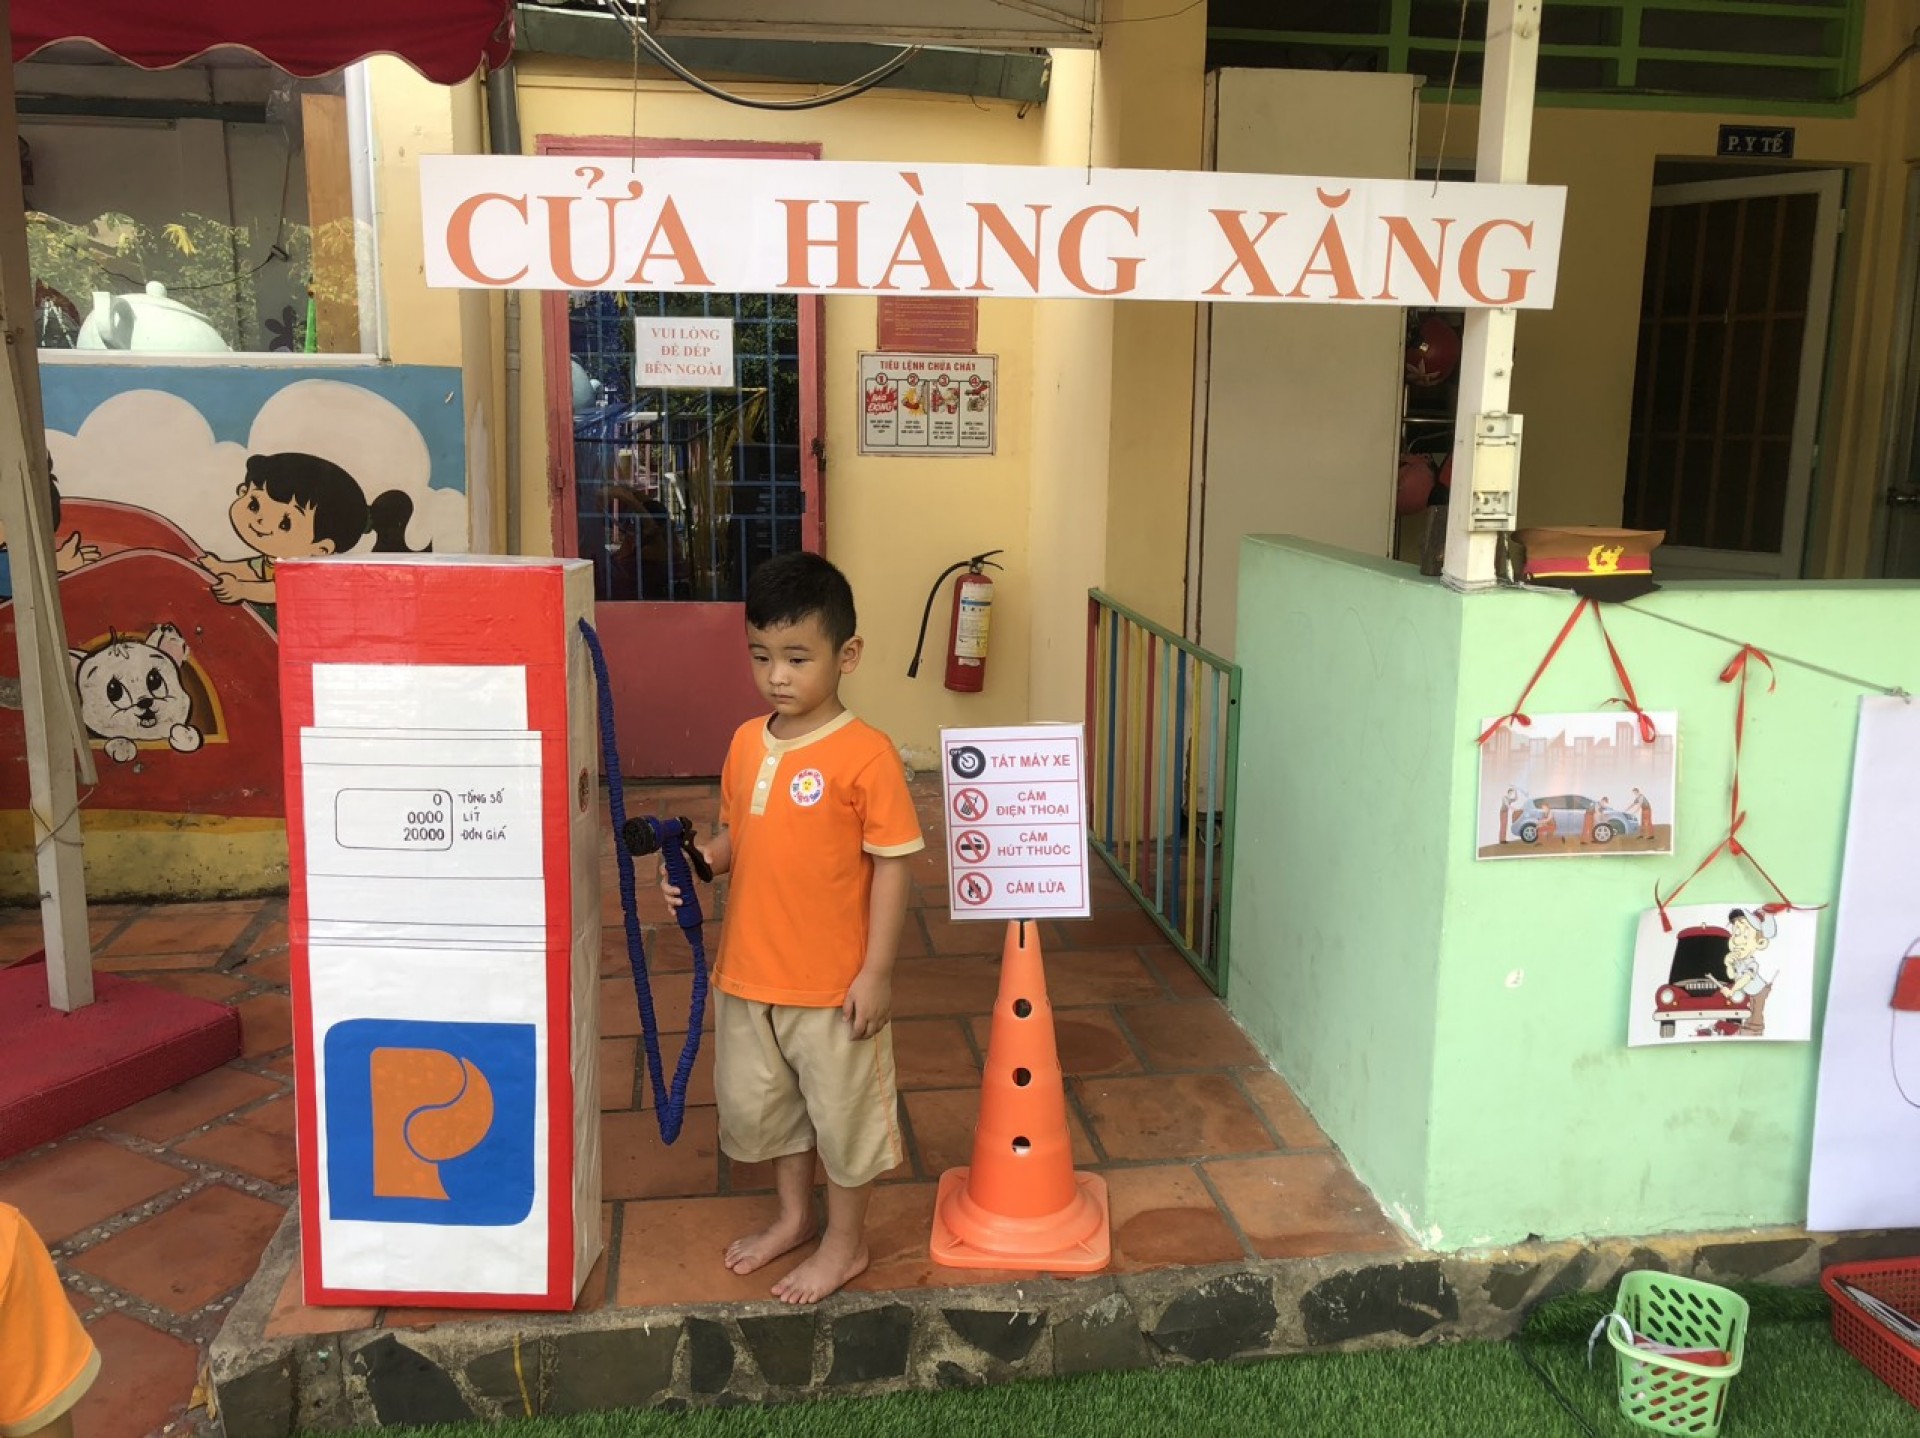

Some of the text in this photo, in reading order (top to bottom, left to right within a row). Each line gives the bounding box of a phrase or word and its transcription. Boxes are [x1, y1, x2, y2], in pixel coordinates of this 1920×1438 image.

[446, 166, 1536, 305] CỬA HÀNG XĂNG
[652, 327, 676, 339] VUI
[684, 343, 711, 357] DÉP
[645, 360, 722, 376] BÊN NGOÀI
[903, 360, 924, 372] LỆNH
[1020, 752, 1049, 767] MÁY
[1053, 754, 1071, 767] XE
[996, 804, 1069, 818] ĐIỆN THOẠI
[403, 827, 445, 841] 20000
[997, 844, 1023, 856] HÚT
